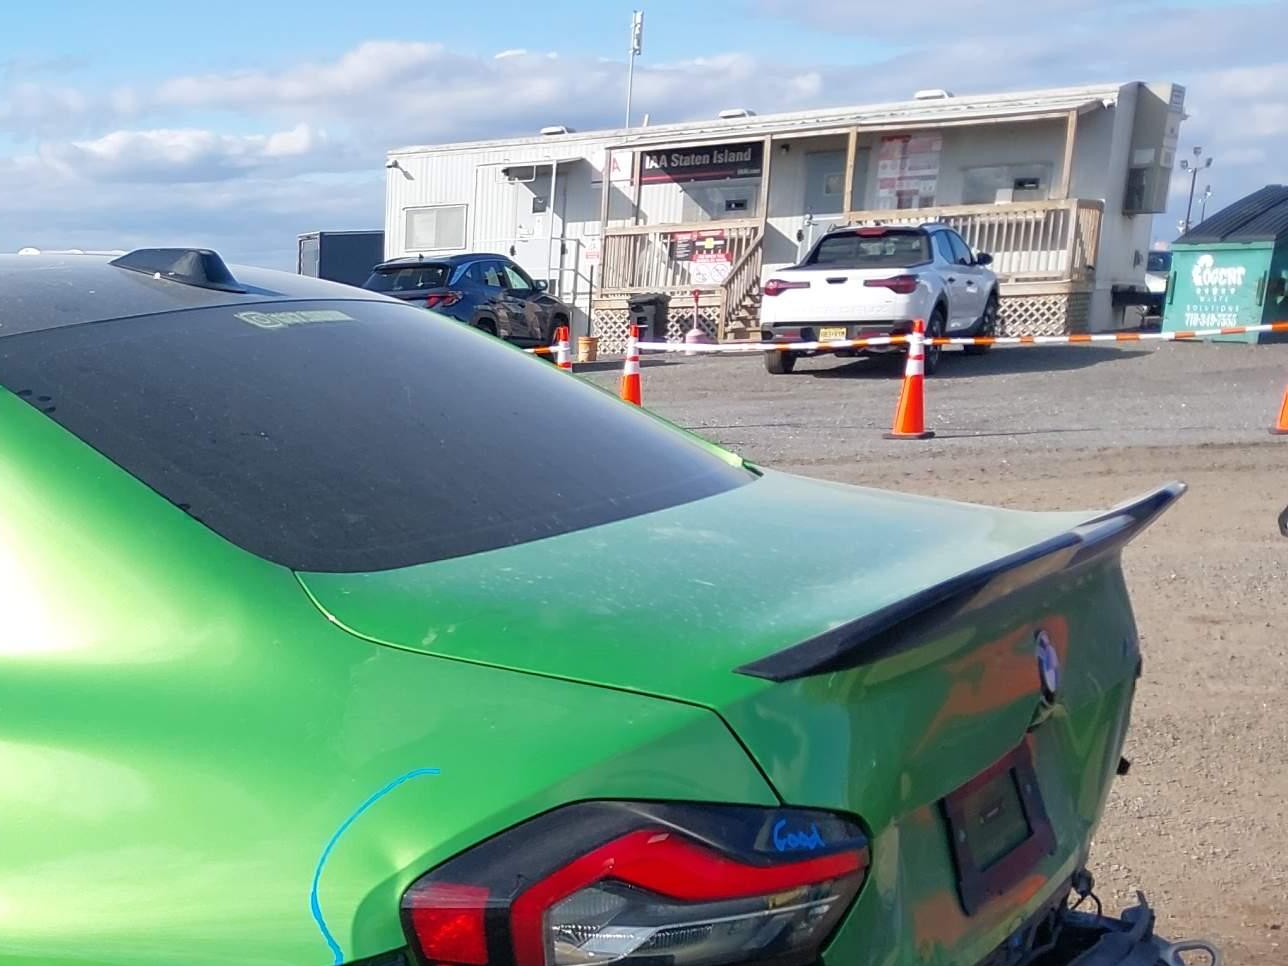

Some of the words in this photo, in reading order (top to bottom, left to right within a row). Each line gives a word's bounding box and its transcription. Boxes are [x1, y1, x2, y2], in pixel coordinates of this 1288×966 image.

[645, 154, 667, 169] IAA
[670, 153, 710, 167] Staten
[712, 148, 752, 163] Island
[773, 818, 826, 852] Good
